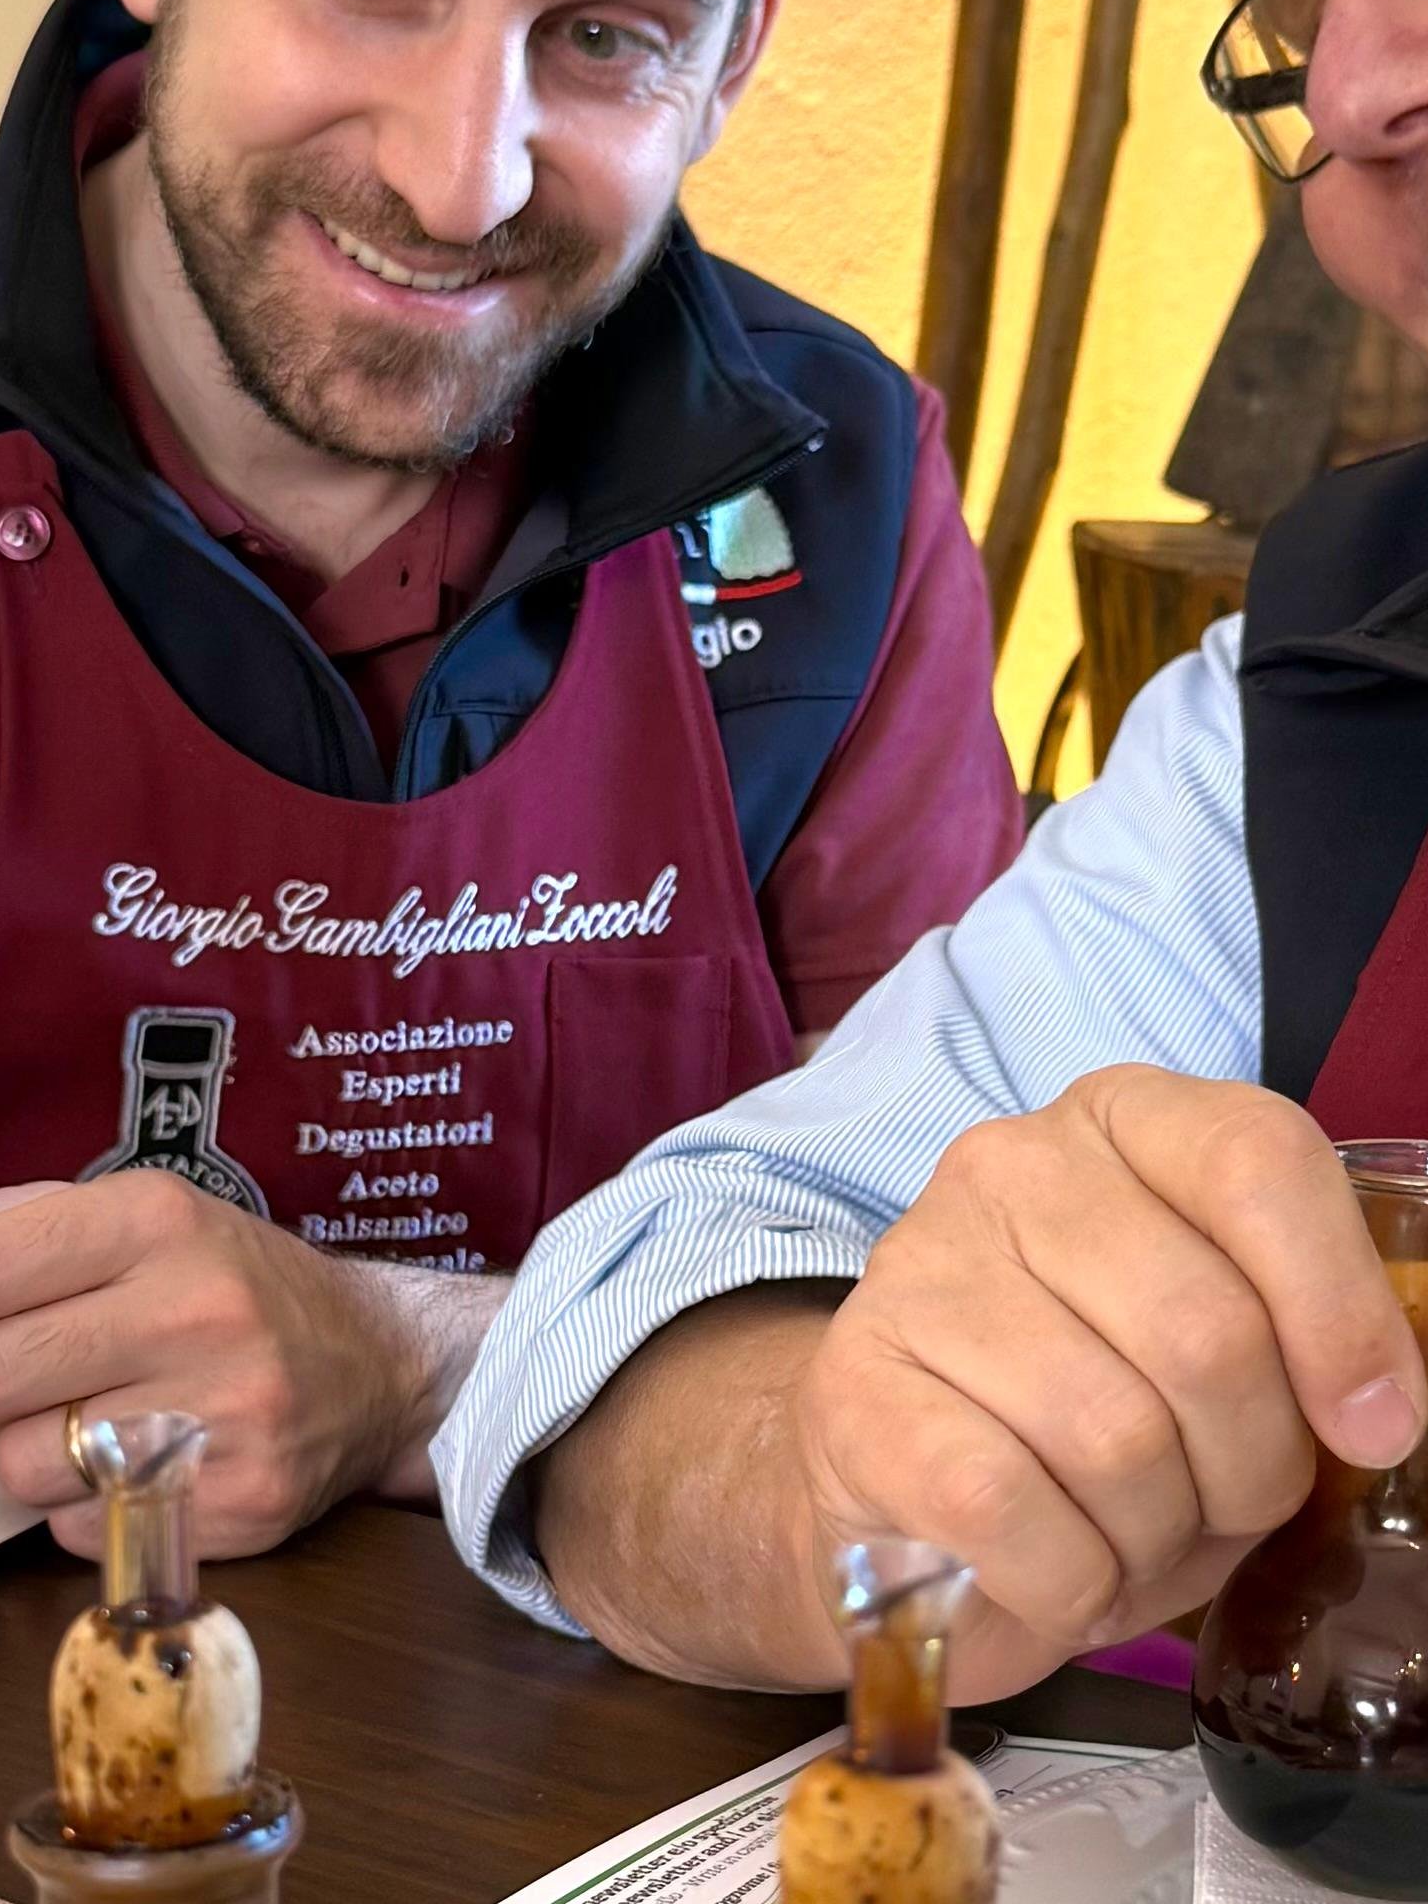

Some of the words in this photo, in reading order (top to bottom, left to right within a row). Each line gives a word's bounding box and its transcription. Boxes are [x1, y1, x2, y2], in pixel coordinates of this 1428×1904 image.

[692, 614, 764, 669] gio
[93, 862, 266, 968] Giorgio
[264, 878, 531, 980] Gambigliani
[526, 864, 679, 947] Zoccoli
[287, 1016, 515, 1059] Associazione
[340, 1062, 462, 1106] Esperti
[294, 1112, 496, 1158] Degustatori
[338, 1169, 440, 1203] Aceto
[299, 1206, 470, 1245] Balsamico
[701, 1835, 740, 1857] and
